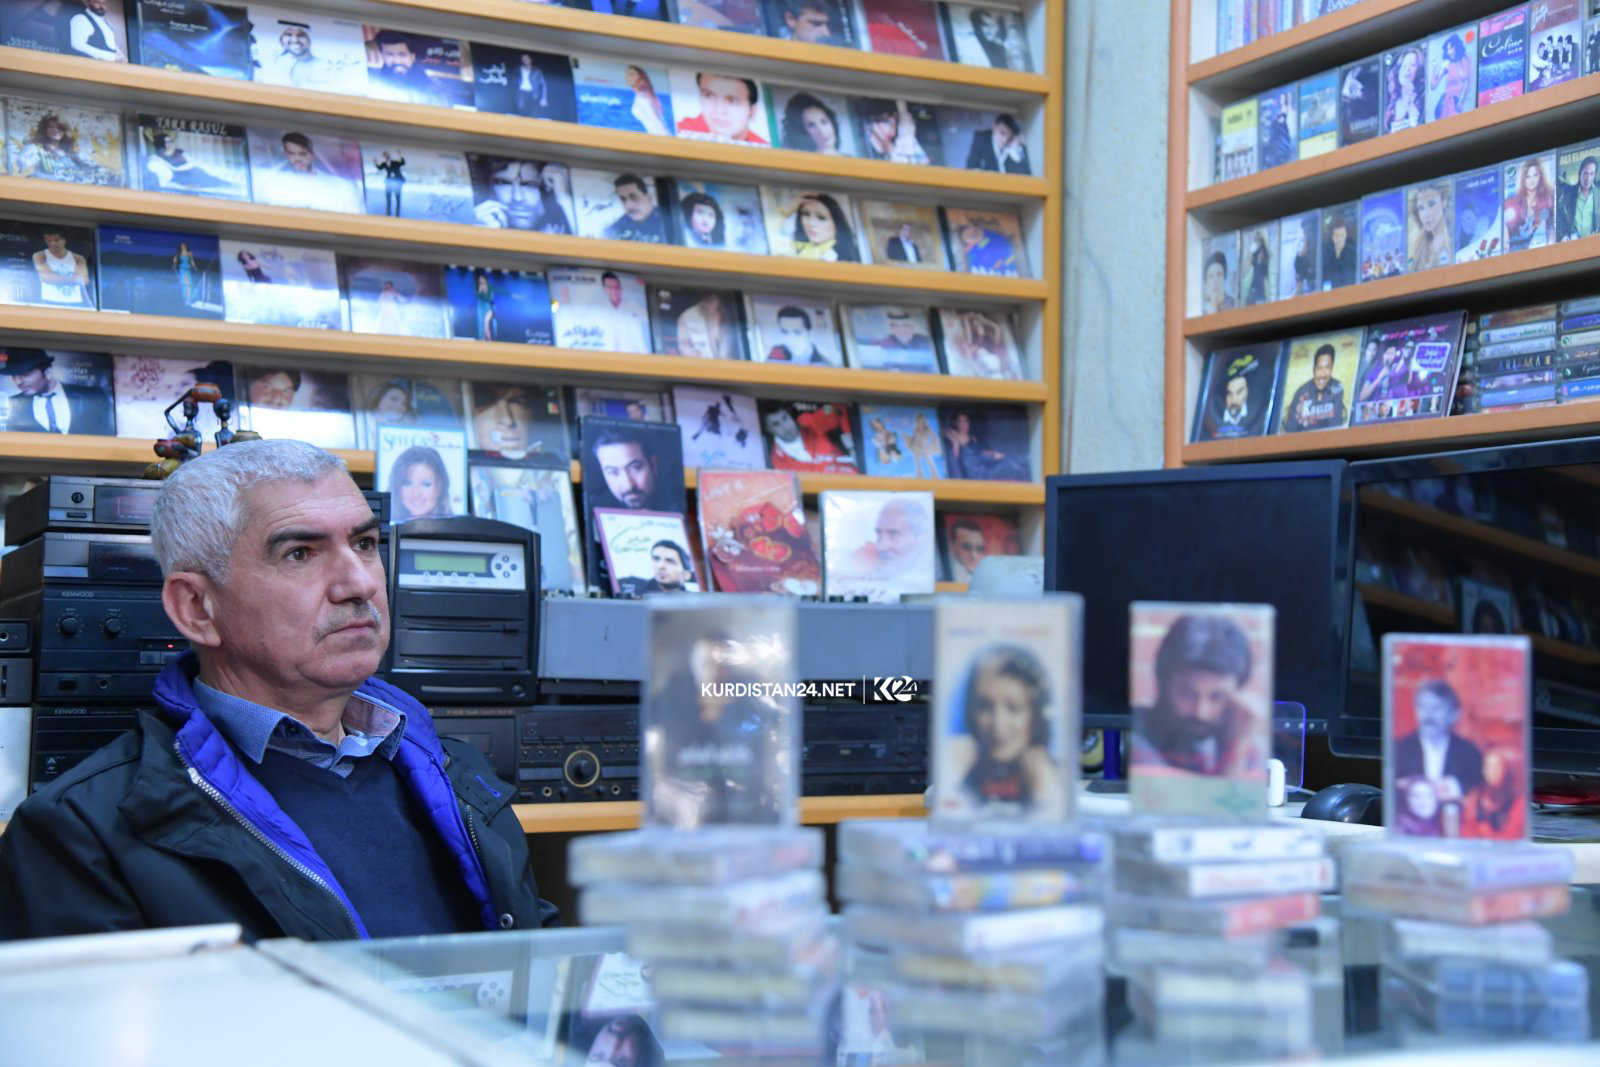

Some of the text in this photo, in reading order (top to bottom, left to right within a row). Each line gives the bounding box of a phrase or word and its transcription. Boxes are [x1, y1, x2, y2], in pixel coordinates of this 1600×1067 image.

[155, 115, 228, 136] TARA RASUL
[63, 533, 97, 541] KENWOOD
[61, 590, 95, 599] KENWOOD
[54, 707, 88, 715] KENWOOD
